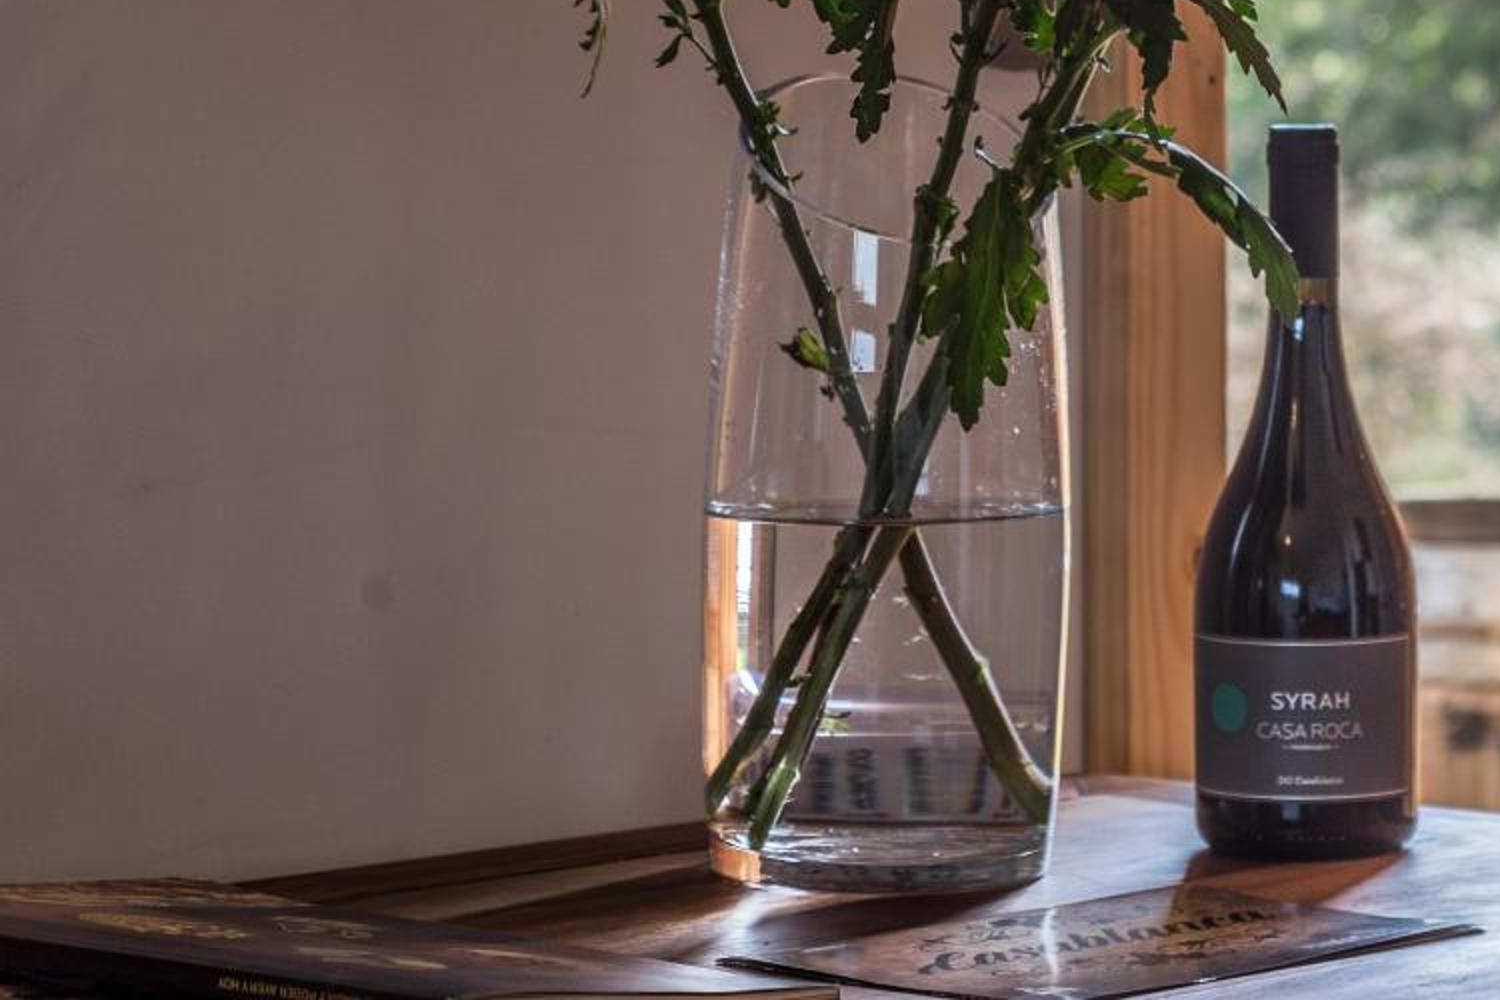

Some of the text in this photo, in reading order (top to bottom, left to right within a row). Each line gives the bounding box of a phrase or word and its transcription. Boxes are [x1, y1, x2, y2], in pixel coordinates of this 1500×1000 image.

[1270, 692, 1351, 711] SYRAH
[1256, 722, 1363, 740] CASA ROCA
